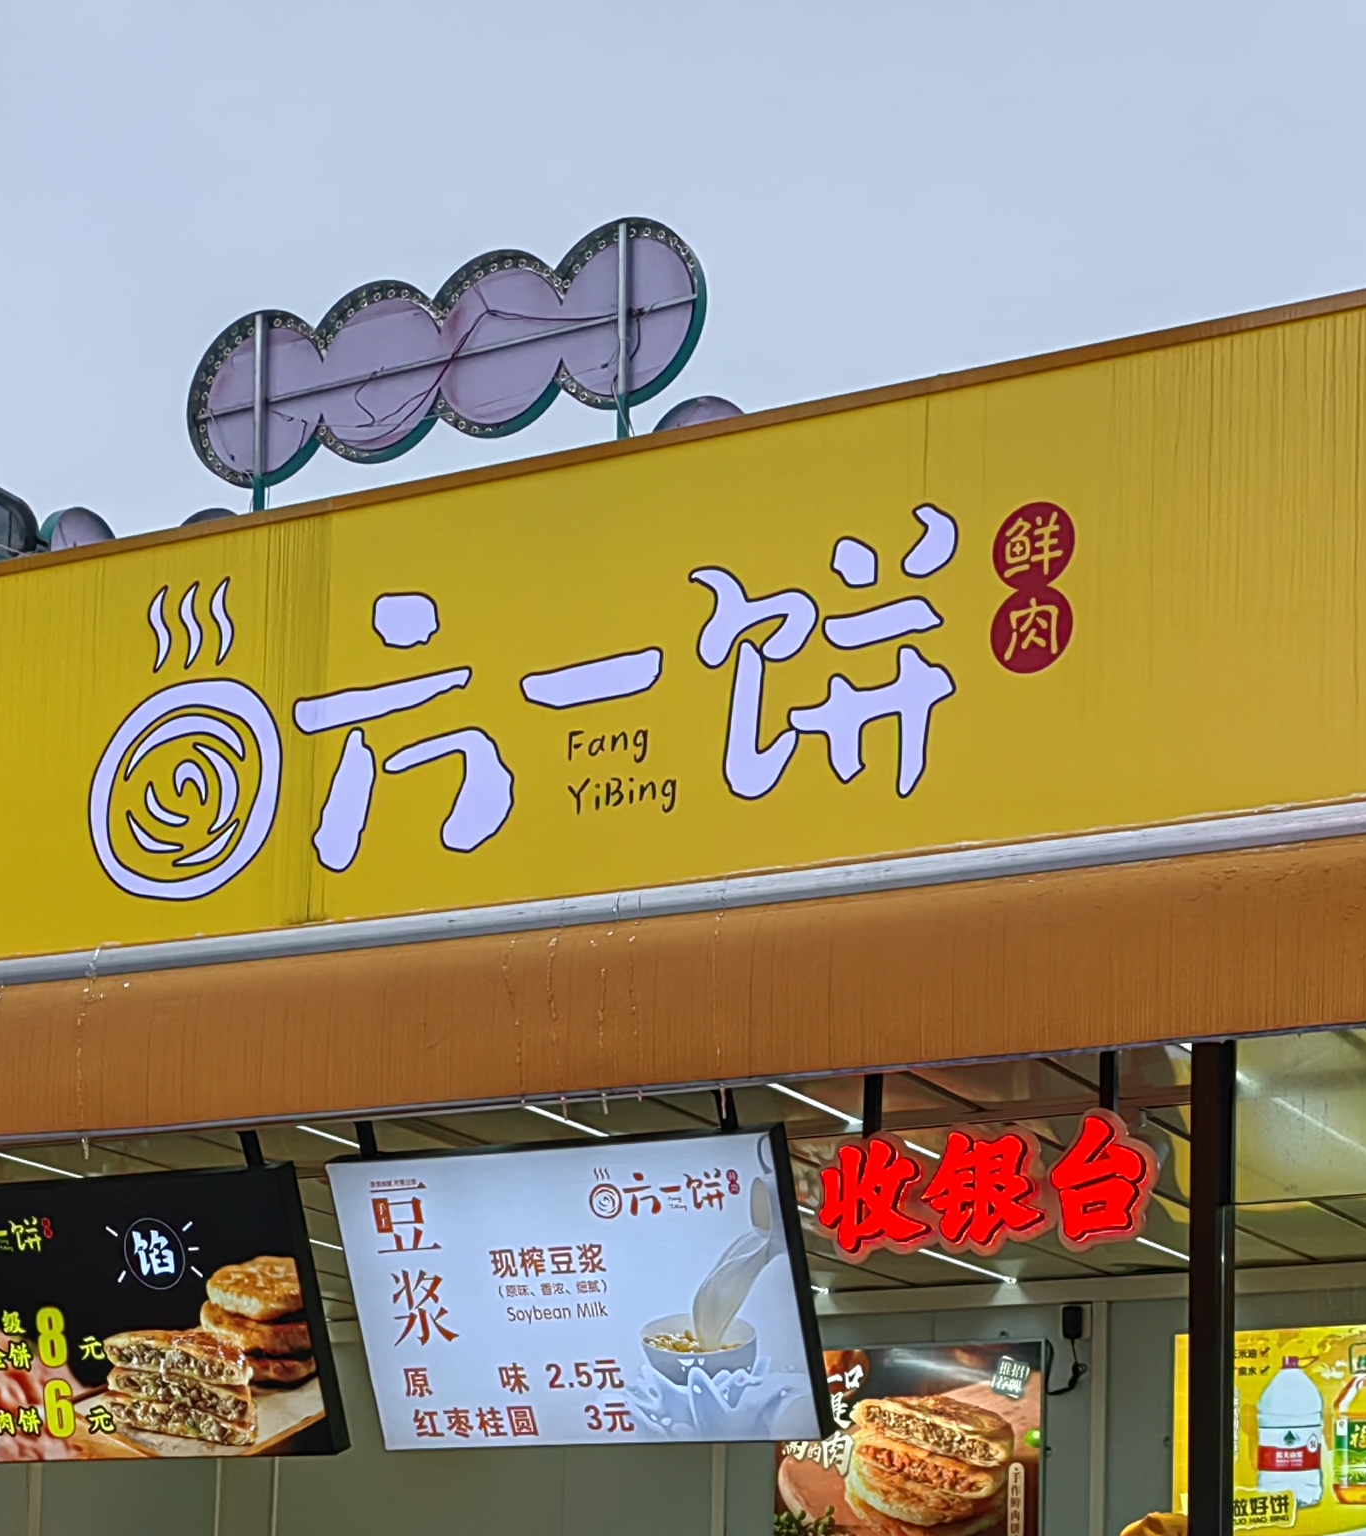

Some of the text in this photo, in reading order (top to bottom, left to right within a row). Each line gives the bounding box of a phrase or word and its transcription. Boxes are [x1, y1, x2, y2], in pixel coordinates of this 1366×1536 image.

[1002, 517, 1064, 663] 鲜肉
[293, 504, 958, 872] 方一饼
[567, 724, 650, 765] Fang
[567, 773, 678, 815] YiBing
[818, 1115, 1149, 1256] 收银台
[131, 1229, 176, 1276] 馅
[370, 1182, 460, 1347] 豆浆
[489, 1243, 607, 1278] 现榨豆浆
[506, 1301, 609, 1325] Soybean Milk
[37, 1306, 68, 1368] 8
[79, 1335, 106, 1361] 元
[1233, 1348, 1258, 1360] 米油
[403, 1359, 625, 1399] 原 味 2.5元
[43, 1378, 76, 1439] 6
[88, 1408, 116, 1433] 元
[412, 1401, 635, 1440] 红枣桂圆 3元
